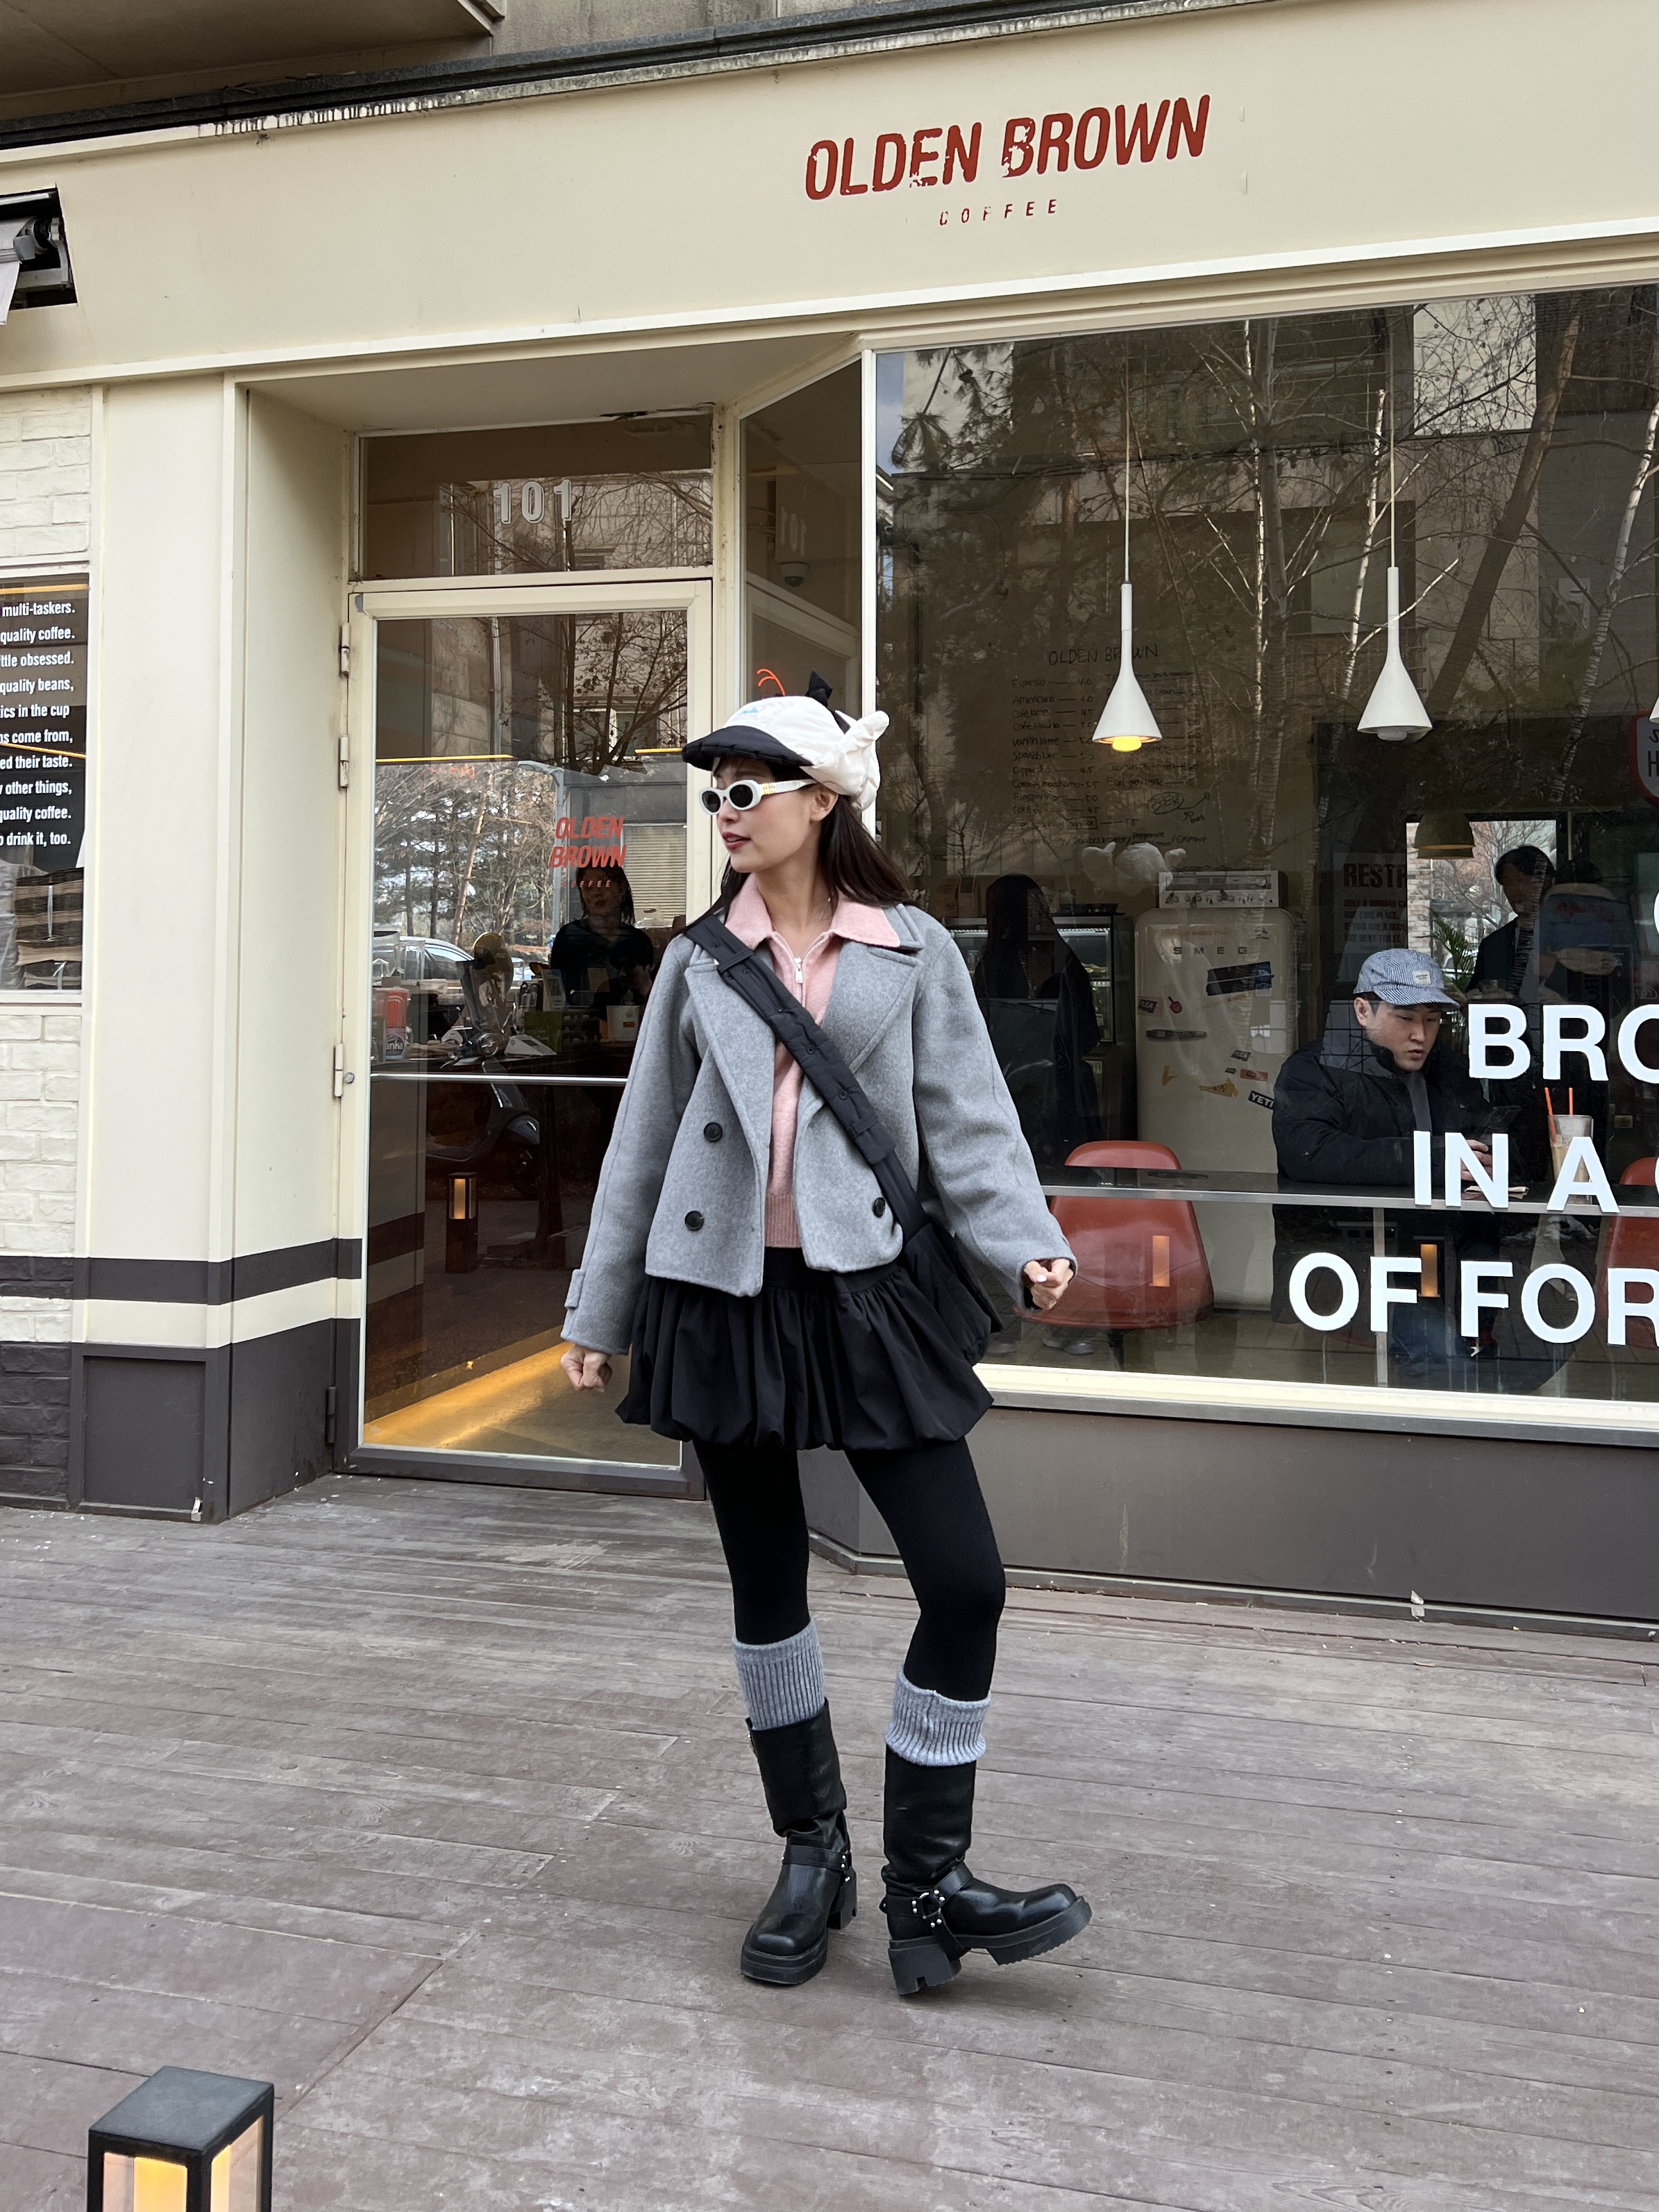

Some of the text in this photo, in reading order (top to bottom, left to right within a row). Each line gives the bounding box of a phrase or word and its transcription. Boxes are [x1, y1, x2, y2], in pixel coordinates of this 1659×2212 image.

[805, 94, 1211, 200] OLDEN BROWN
[939, 199, 1057, 226] COFFEE
[493, 478, 573, 525] 101
[2, 601, 76, 617] multi-taskers.
[1, 626, 76, 645] quality coffee.
[0, 651, 74, 668] ttle obsessed.
[1048, 644, 1158, 666] OLDEN BRWN
[0, 678, 74, 696] quality beans,
[0, 703, 70, 719] ics in the cup
[12, 732, 42, 744] come
[44, 729, 73, 744] from,
[15, 755, 40, 769] their
[42, 755, 73, 768] taste.
[6, 781, 33, 794] other
[35, 780, 72, 796] things,
[35, 806, 71, 820] coffee.
[555, 816, 624, 839] OLDEN
[7, 832, 33, 846] drink
[36, 832, 47, 847] it,
[50, 832, 71, 845] too.
[549, 845, 627, 869] BROWN
[1173, 946, 1247, 955] SMEG
[1252, 1092, 1274, 1108] YETI
[1413, 1130, 1509, 1209] IN
[1546, 1136, 1620, 1214] A
[1289, 1252, 1659, 1346] OF FOR
